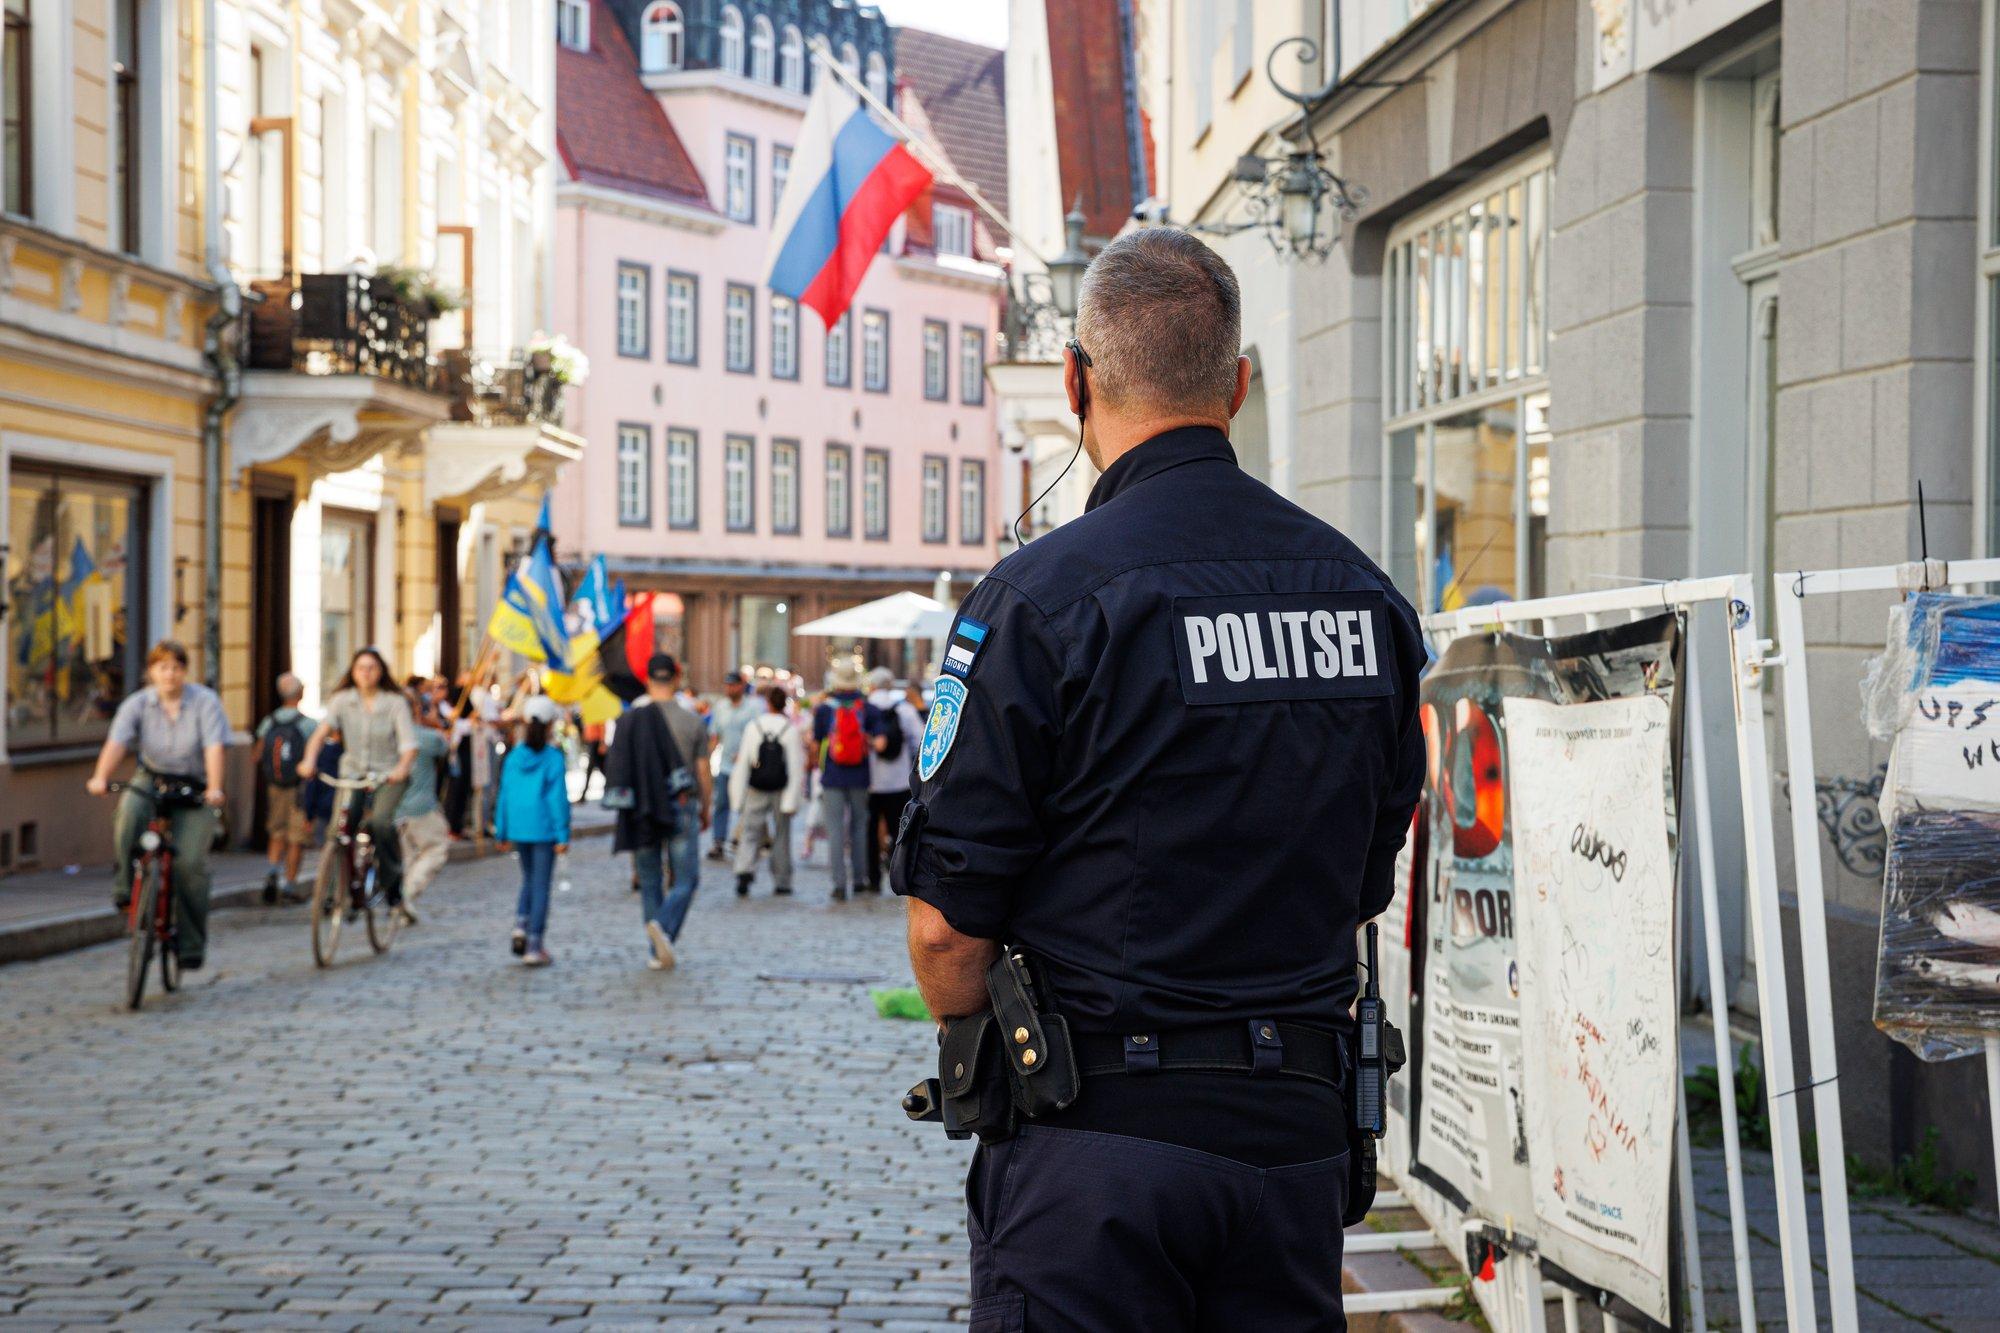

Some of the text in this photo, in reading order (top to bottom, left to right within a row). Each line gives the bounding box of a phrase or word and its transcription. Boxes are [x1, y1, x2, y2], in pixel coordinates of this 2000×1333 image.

[1184, 609, 1380, 684] POLITSEI
[944, 657, 969, 674] ESTONIA
[937, 683, 963, 702] POLITSEI
